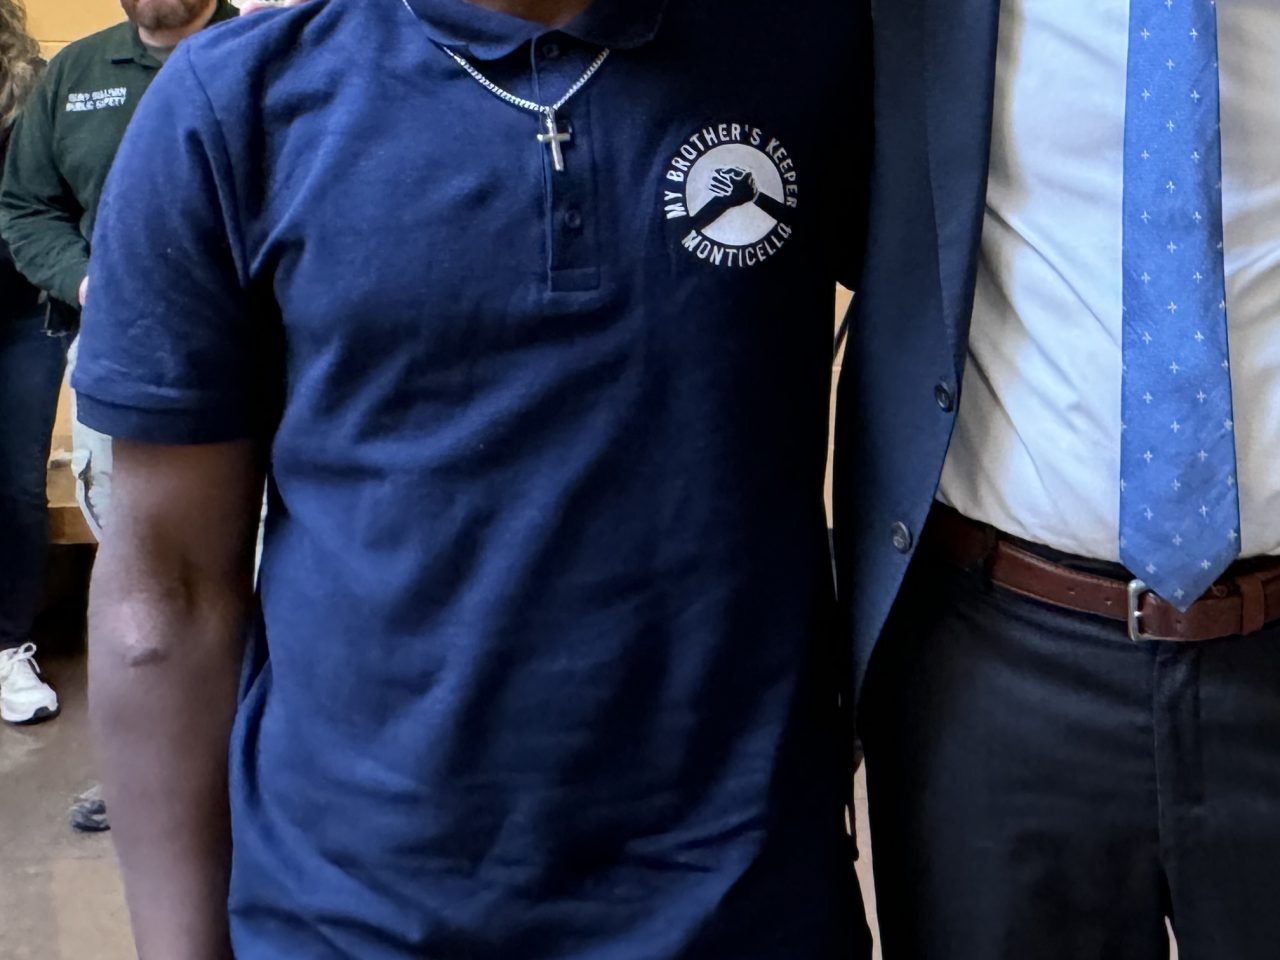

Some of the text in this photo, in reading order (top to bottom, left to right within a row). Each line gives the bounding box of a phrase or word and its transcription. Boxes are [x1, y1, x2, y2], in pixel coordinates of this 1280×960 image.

[663, 123, 798, 219] MY BROTHER'S KEEPER
[681, 221, 792, 267] MONTICELLO
